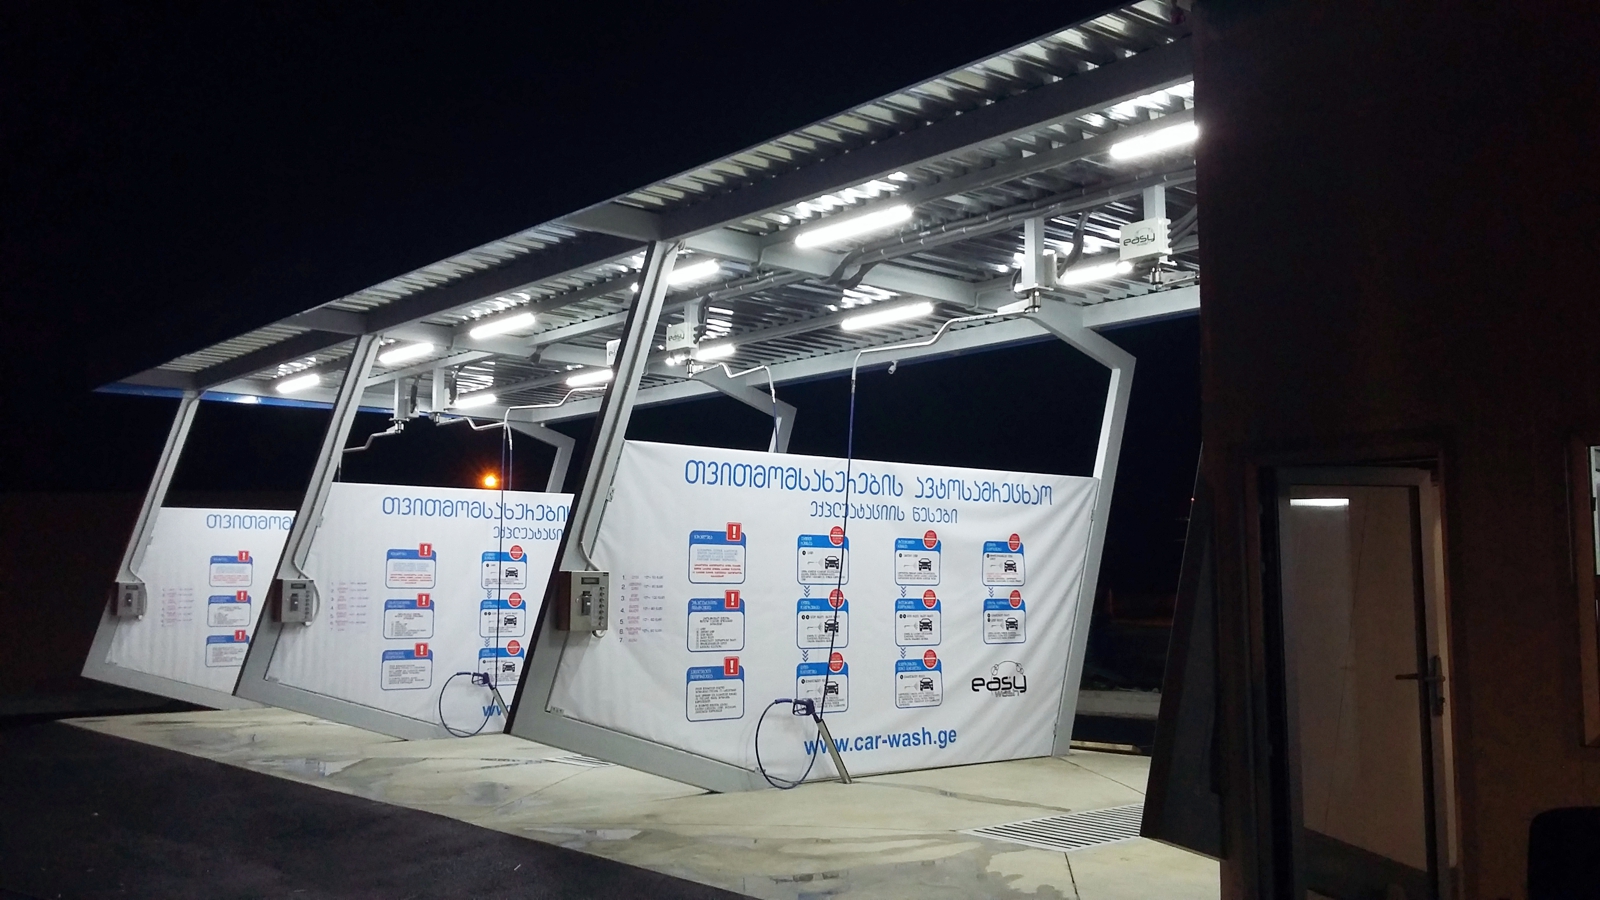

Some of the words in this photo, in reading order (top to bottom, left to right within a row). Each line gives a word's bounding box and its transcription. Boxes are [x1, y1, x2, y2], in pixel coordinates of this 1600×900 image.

[1123, 233, 1156, 247] easy
[684, 459, 904, 498] თვითმომსახურების
[382, 496, 570, 522] თვითმომსახურები
[912, 506, 958, 524] წესები
[206, 513, 293, 531] თვითმომ
[971, 674, 1028, 693] easy
